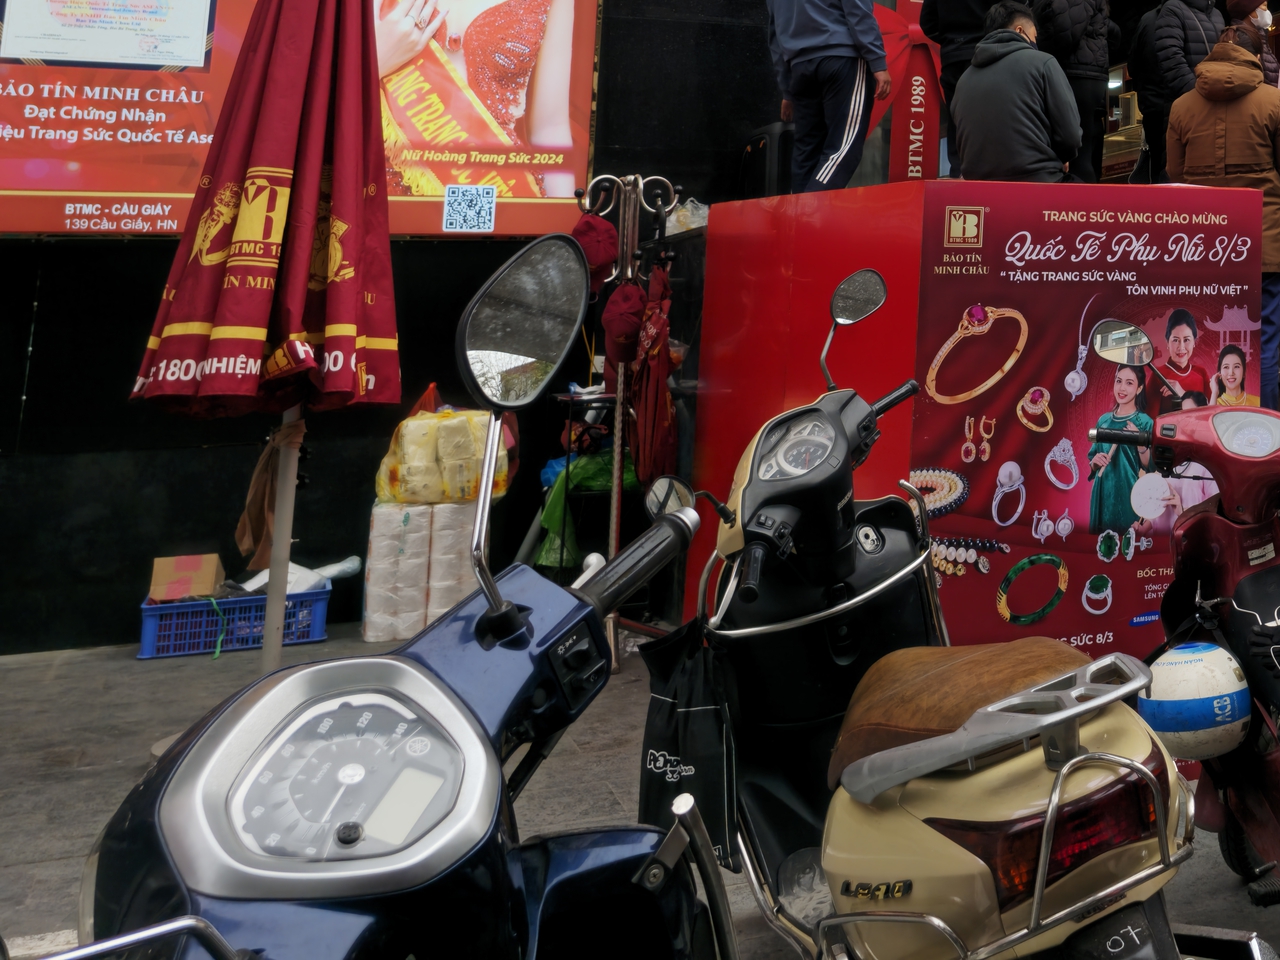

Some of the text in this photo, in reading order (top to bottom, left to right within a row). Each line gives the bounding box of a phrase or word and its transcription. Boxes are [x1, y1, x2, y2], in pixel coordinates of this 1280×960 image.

[40, 81, 78, 99] TÍN
[83, 86, 141, 101] MINH
[145, 86, 205, 104] CHÂU
[24, 104, 167, 125] Đạt Chứng Nhận
[0, 125, 215, 145] iệu Trang Sức Quốc Tế Ase
[907, 75, 927, 179] BTMC 1989
[401, 148, 564, 165] Nữ Hoàng Trang Sức 2024
[65, 204, 102, 215] BTMC
[1042, 209, 1229, 225] TRANG SỨC VÀNG CHÀO MỪNG
[64, 216, 178, 232] 139 Cầu Giấy, HN
[943, 251, 982, 263] BẢO TÍN
[1004, 230, 1067, 267] Quốc
[1070, 230, 1108, 263] Tế
[1106, 232, 1162, 267] Phụ
[1163, 232, 1206, 263] Nữ
[1208, 233, 1252, 268] 8/3
[933, 264, 990, 275] MINH CHÂU
[1008, 269, 1137, 284] TẶNG TRANG SỨC VÀNG
[1126, 283, 1242, 298] TÔN VINH PHỤ NỮ VIỆT
[1136, 567, 1157, 578] BỐC
[1132, 614, 1160, 624] SAMSUNG
[1070, 632, 1094, 647] SỨC
[1095, 631, 1114, 644] 8/3
[1213, 695, 1232, 723] ACB
[317, 717, 334, 735] 100
[356, 711, 373, 729] 120
[392, 722, 408, 740] 140
[251, 804, 266, 819] 40
[265, 832, 282, 847] 20
